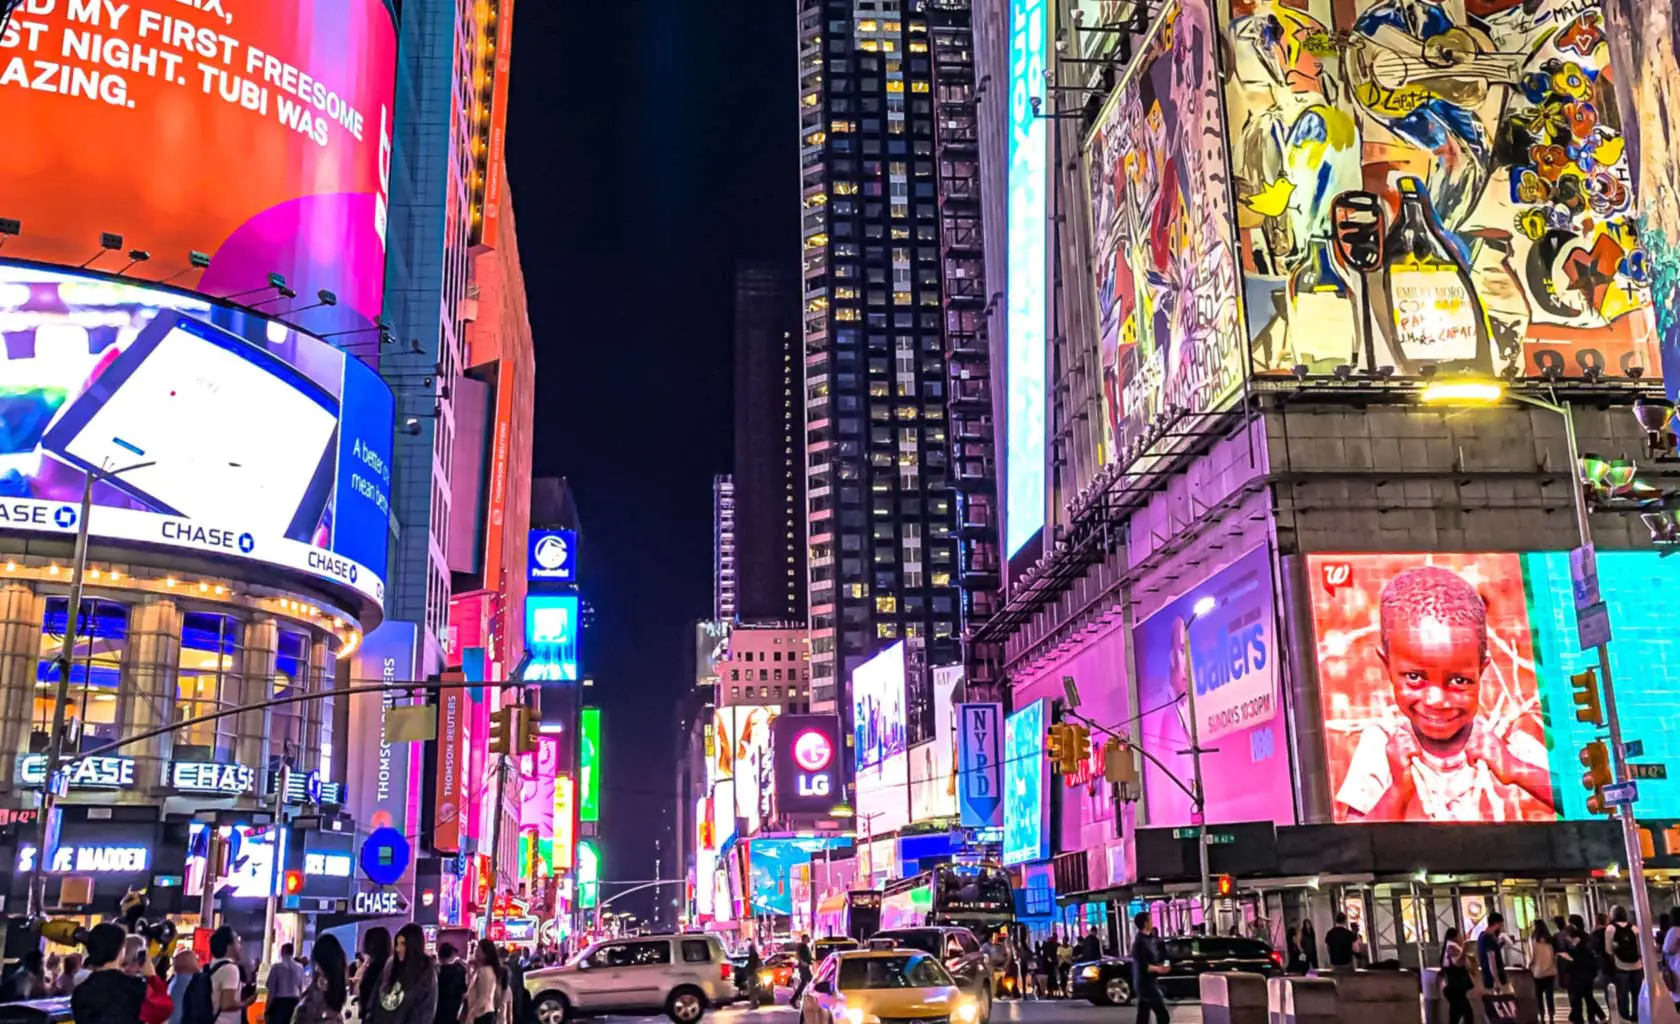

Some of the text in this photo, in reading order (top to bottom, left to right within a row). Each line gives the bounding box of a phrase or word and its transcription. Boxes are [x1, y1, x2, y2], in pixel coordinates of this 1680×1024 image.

[0, 57, 135, 108] AZING.
[67, 0, 131, 30] MY
[139, 11, 239, 64] FIRST
[247, 46, 364, 141] FREESOME
[62, 28, 185, 85] NIGHT.
[198, 62, 268, 115] TUBI
[276, 95, 328, 146] WAS
[352, 437, 361, 459] A
[162, 520, 234, 548] CHASE
[307, 550, 349, 578] CHASE
[1190, 623, 1267, 697] ballers
[1208, 703, 1241, 734] SUNDAYS
[443, 695, 457, 797] THOMSON REUTERS
[974, 710, 990, 797] NYPD
[173, 762, 254, 792] CHASE
[798, 774, 829, 796] LG
[76, 847, 147, 872] MADDEN
[355, 893, 398, 913] CHASE
